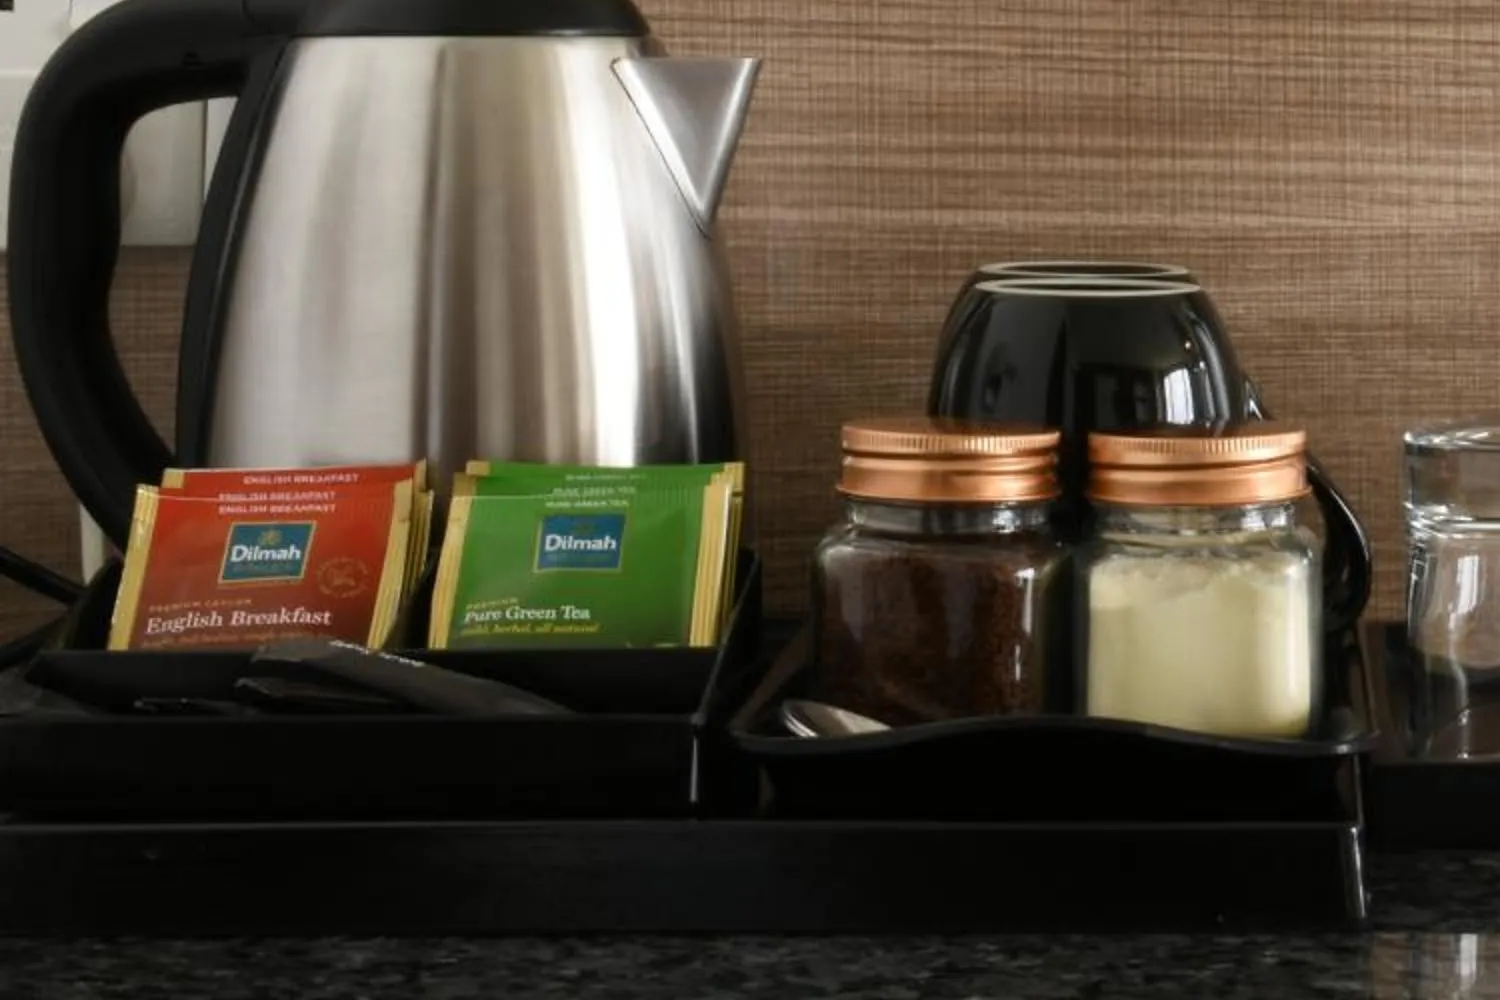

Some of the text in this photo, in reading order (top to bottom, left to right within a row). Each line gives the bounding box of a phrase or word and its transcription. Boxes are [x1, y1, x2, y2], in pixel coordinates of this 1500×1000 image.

[544, 533, 617, 552] Dilmah
[230, 543, 302, 563] Dilmah
[145, 606, 332, 635] English Breakfast
[464, 605, 591, 624] Pure Green Tea
